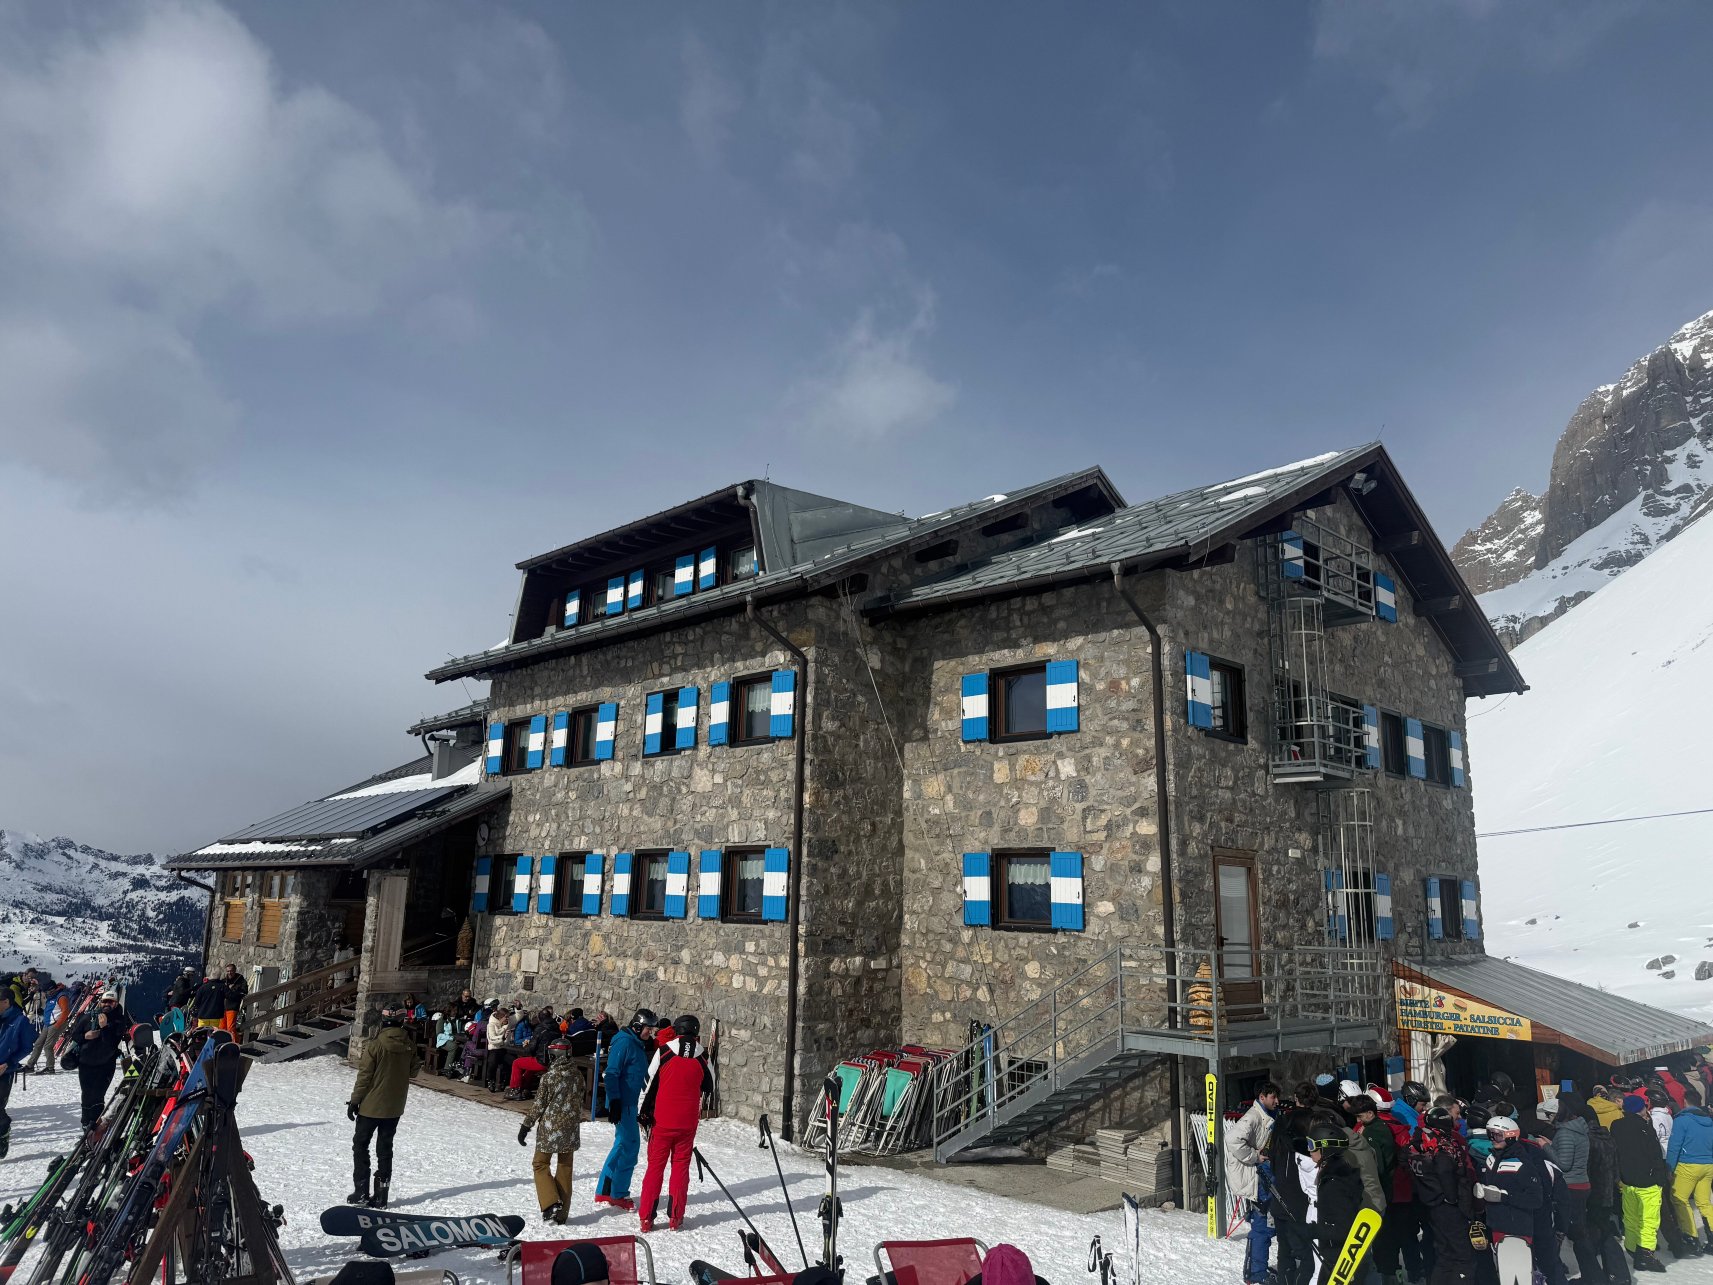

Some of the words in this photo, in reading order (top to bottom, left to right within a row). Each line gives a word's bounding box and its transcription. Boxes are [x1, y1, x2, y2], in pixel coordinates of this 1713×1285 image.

[1400, 1009, 1462, 1021] HAMBURGER
[1470, 1014, 1522, 1027] SALSICCIA
[1401, 1019, 1446, 1031] WURSTEL
[1453, 1023, 1499, 1035] PATATINE
[376, 1217, 511, 1251] SALOMON
